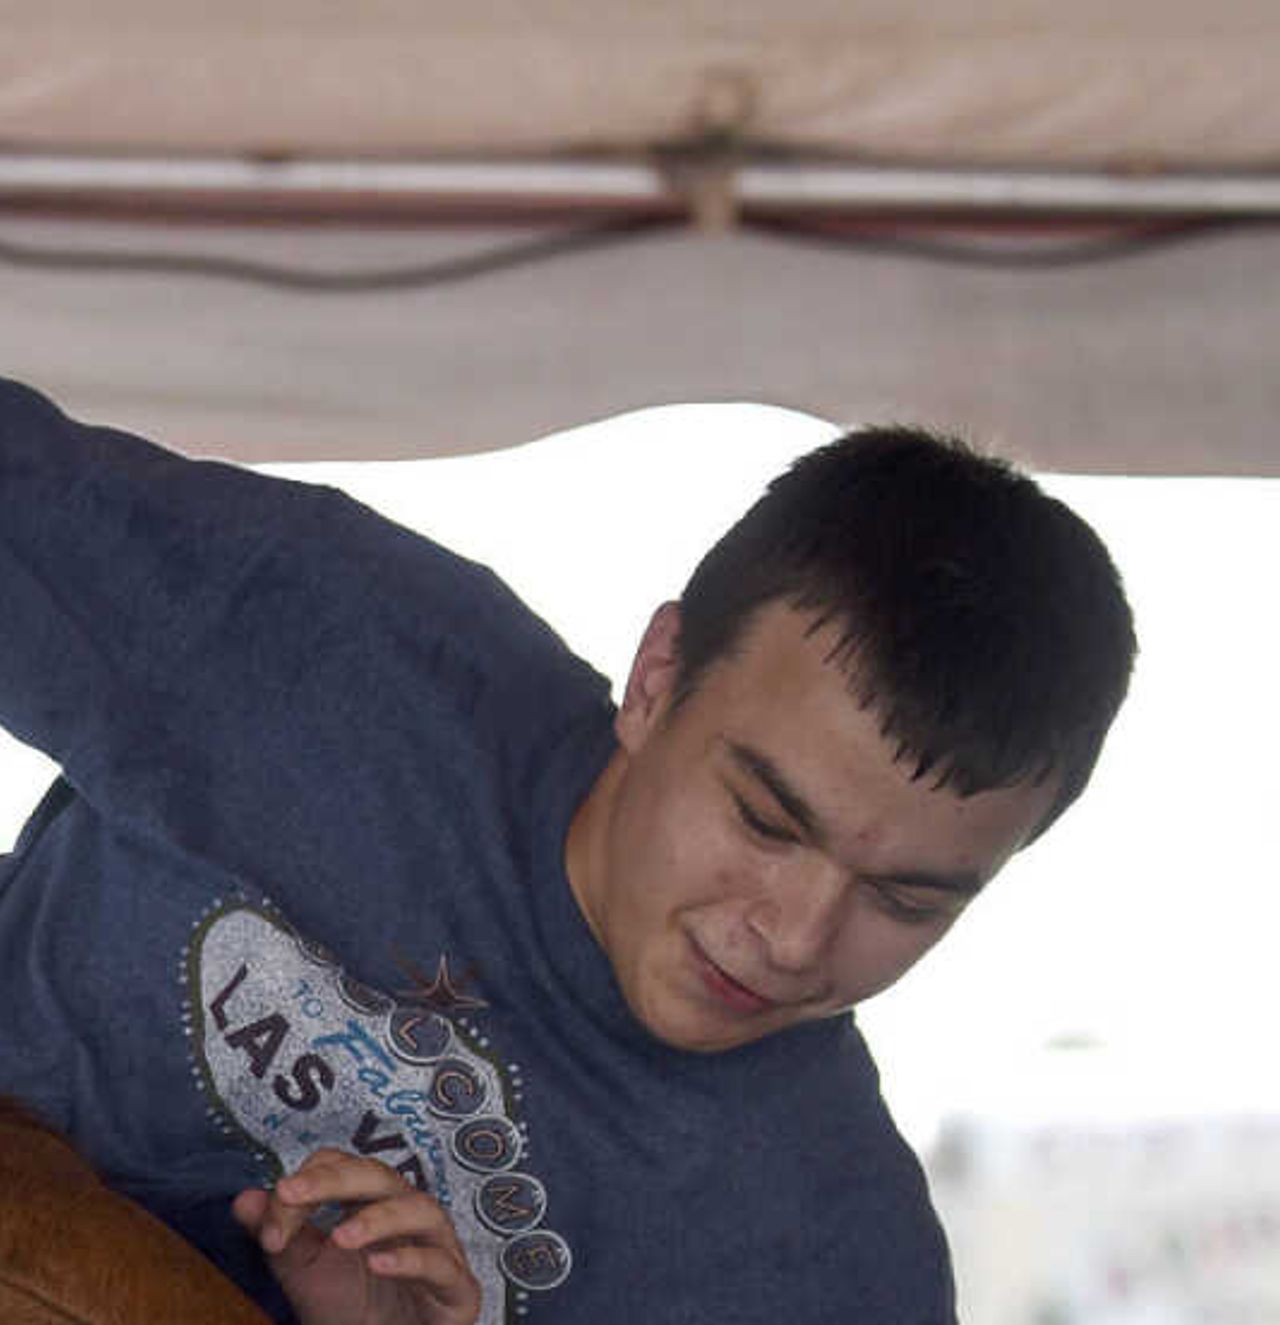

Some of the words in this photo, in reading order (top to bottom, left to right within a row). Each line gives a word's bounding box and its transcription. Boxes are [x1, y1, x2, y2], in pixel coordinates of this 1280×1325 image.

[210, 963, 336, 1111] LAS
[312, 1018, 451, 1206] Fabu
[330, 965, 568, 1284] LCOME
